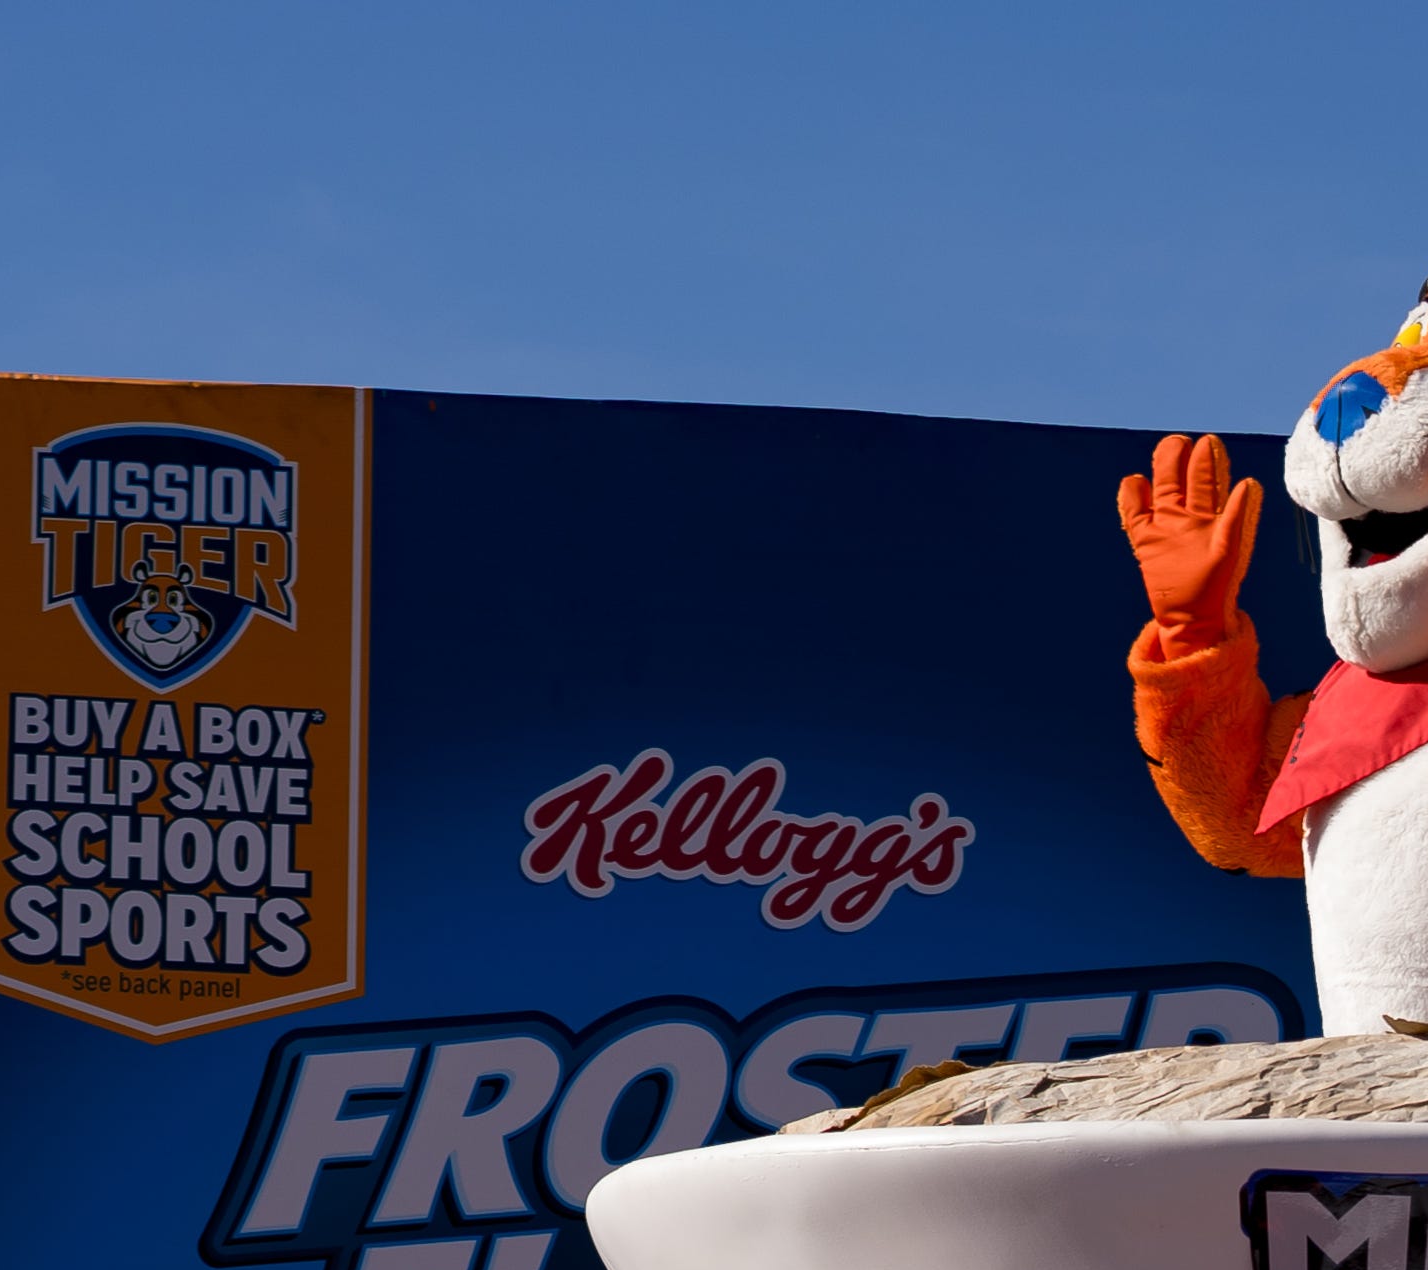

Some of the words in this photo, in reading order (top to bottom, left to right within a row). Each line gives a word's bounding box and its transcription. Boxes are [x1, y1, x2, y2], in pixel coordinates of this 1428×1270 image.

[41, 458, 289, 525] MISSION
[41, 518, 290, 614] TIGER
[13, 697, 128, 748] BUY
[144, 704, 180, 752] A
[13, 756, 152, 806] HELP
[170, 764, 307, 815] SAVE
[10, 810, 307, 889] SCHOOL
[524, 750, 972, 930] Kellogg's
[9, 886, 307, 968] SPORTS
[119, 973, 171, 997] back
[178, 977, 241, 1001] panel
